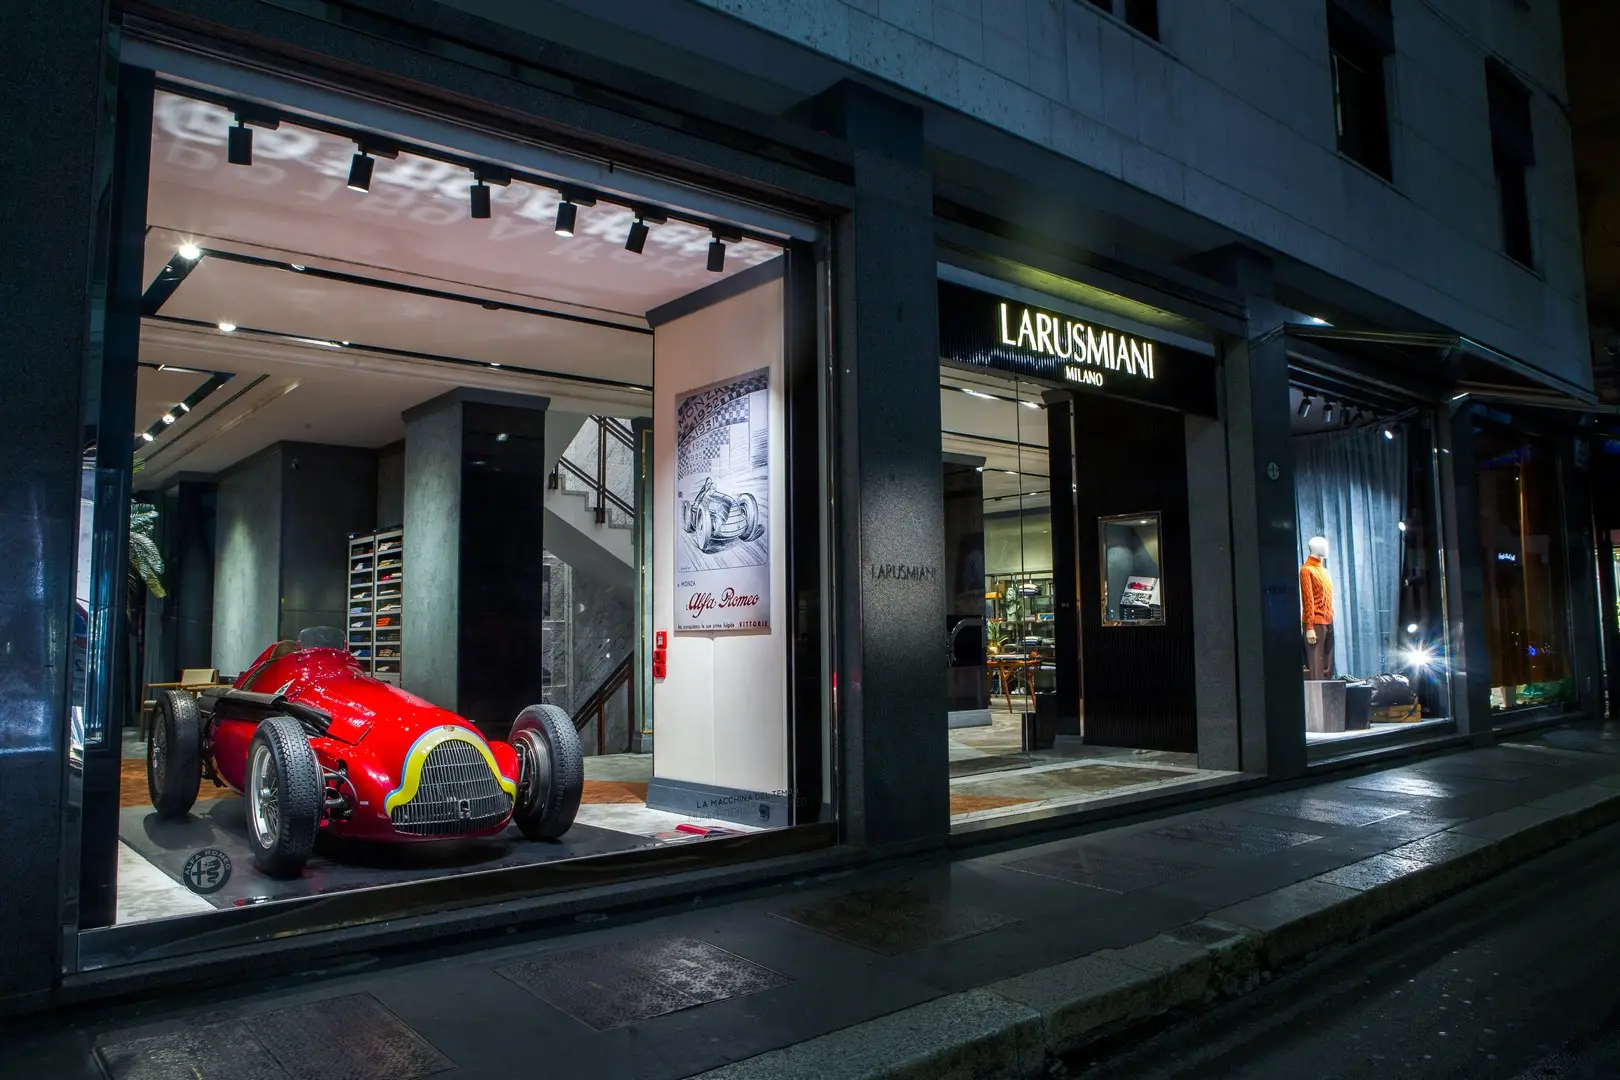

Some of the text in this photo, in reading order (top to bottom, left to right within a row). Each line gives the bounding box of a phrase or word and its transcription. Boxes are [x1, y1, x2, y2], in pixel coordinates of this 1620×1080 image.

[1000, 303, 1155, 379] LARUSMIANI
[1065, 365, 1104, 387] MILANO
[678, 387, 724, 428] MONZA
[694, 397, 720, 424] 1932
[695, 416, 715, 436] 1931
[871, 564, 937, 581] LARUSMIANI
[681, 580, 696, 588] MONZA
[718, 587, 760, 608] Romeo
[739, 620, 768, 628] VITTORIE
[696, 801, 708, 809] LA
[710, 794, 753, 807] MACCHINA
[755, 791, 770, 800] DEL
[184, 850, 231, 876] ALFA ROMEO
